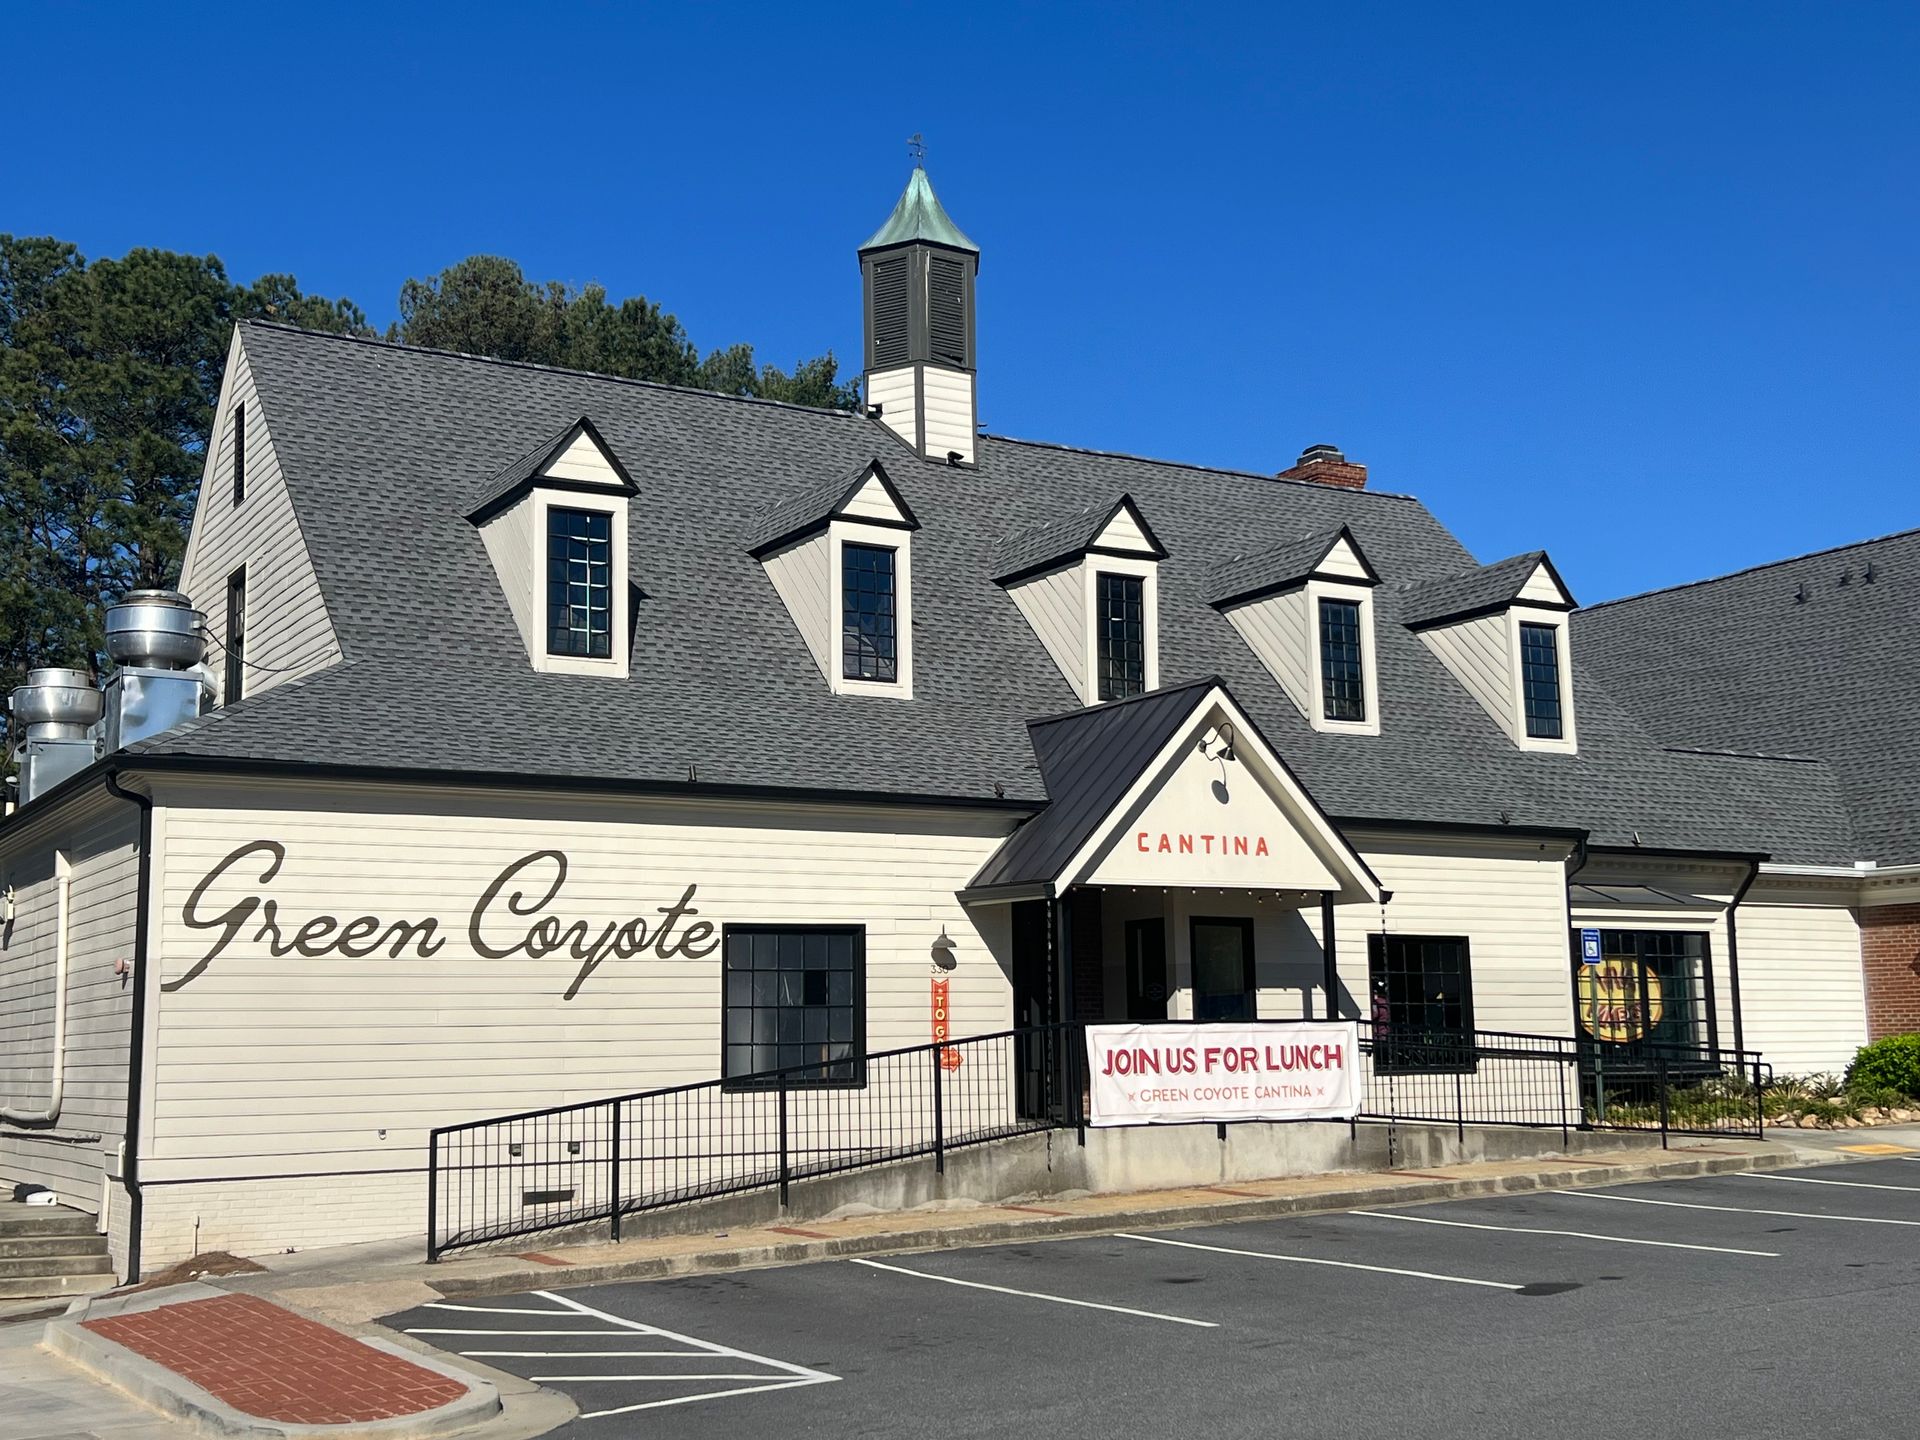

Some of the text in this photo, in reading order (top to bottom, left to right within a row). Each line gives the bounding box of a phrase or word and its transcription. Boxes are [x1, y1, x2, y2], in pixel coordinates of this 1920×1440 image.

[1137, 832, 1269, 857] CANTINA
[160, 840, 721, 1000] Green Coyote
[1101, 1044, 1343, 1076] JOIN US FOR LUNCH
[1140, 1085, 1312, 1102] GREEN COYOTE CANTINA
